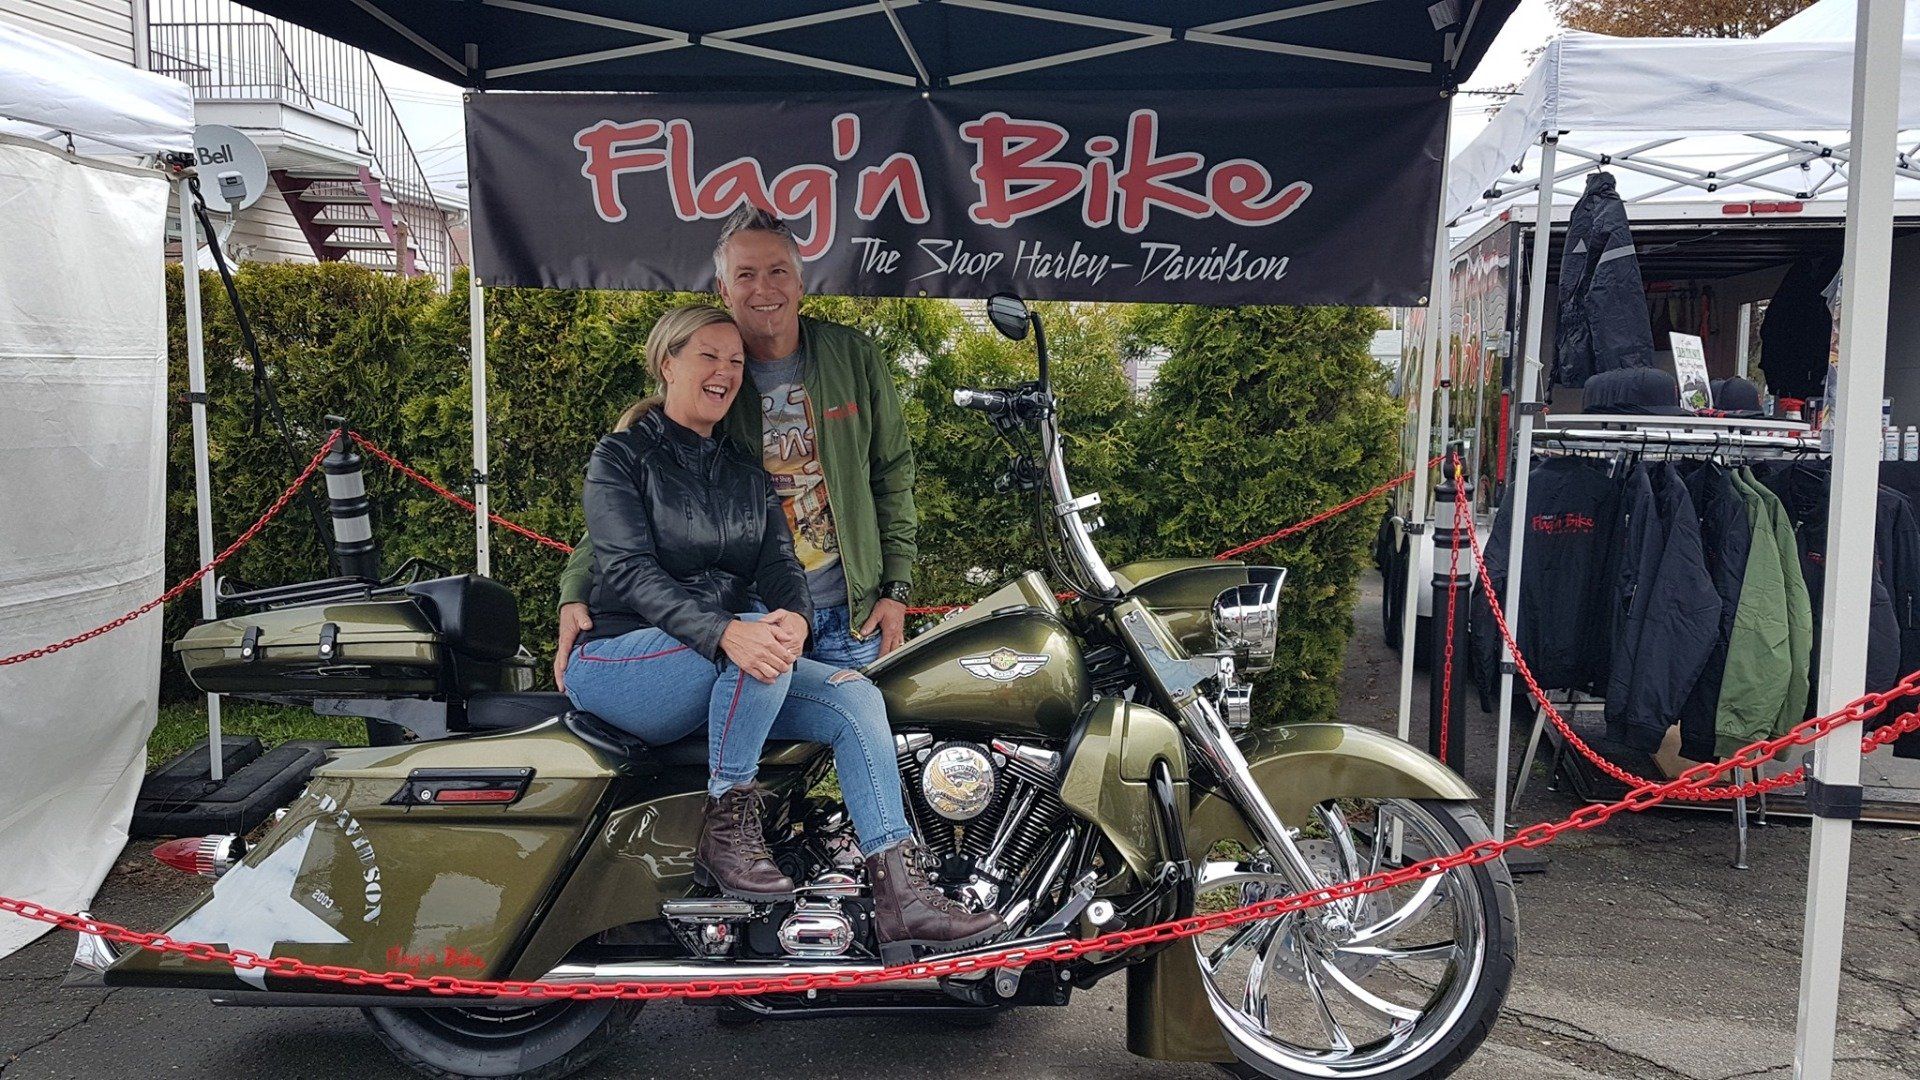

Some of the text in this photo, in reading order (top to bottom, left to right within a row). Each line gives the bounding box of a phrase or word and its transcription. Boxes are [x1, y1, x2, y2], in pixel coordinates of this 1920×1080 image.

[196, 144, 234, 166] Bell
[573, 109, 1313, 261] Flag'n Bike
[851, 237, 901, 275] The
[910, 238, 1004, 282] Shop
[311, 889, 334, 909] 2003
